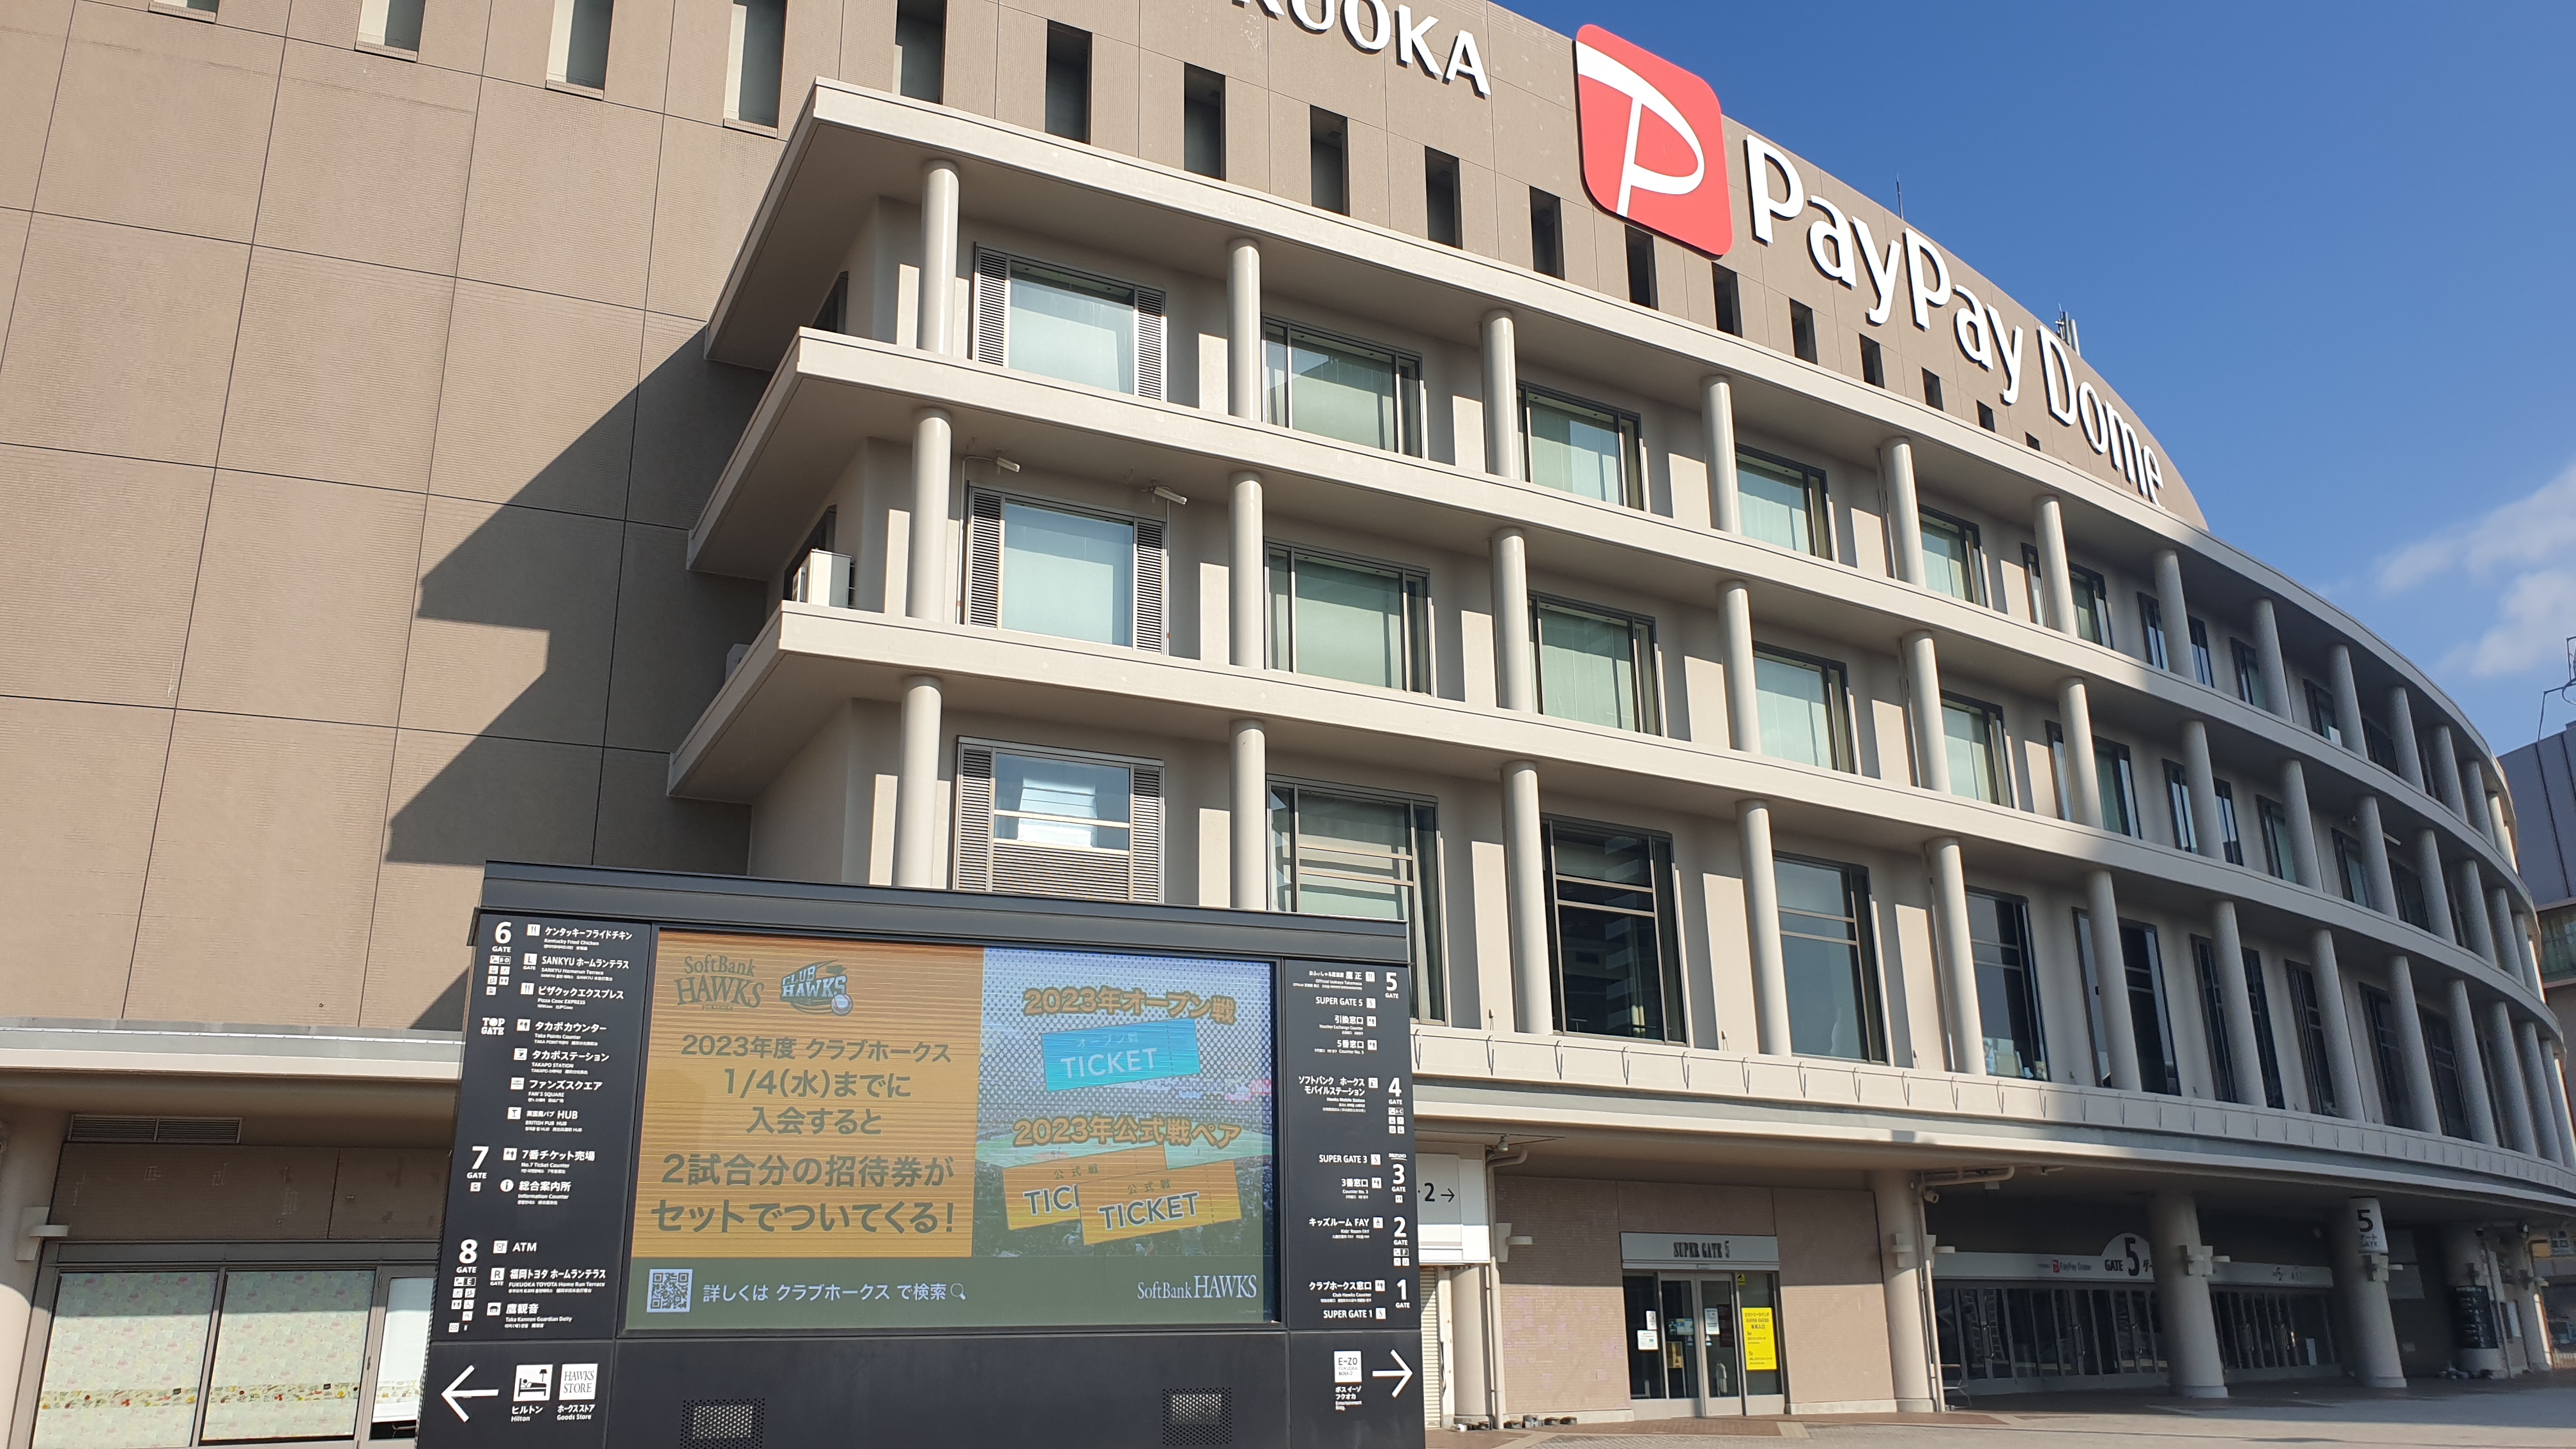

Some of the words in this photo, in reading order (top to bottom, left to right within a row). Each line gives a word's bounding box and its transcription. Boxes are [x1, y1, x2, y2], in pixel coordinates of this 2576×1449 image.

[1232, 0, 1491, 96] UOKA
[1746, 134, 2023, 406] PayPay
[2039, 325, 2166, 509] Dome
[495, 921, 512, 944] 6
[545, 927, 632, 940] ケンタッキーフライドチキン
[542, 956, 575, 966] SANKYU
[576, 958, 629, 969] ホームランテラス
[685, 954, 757, 977] SoftBank
[783, 965, 816, 986] CLUB
[1386, 972, 1398, 991] 5
[674, 974, 765, 1008] HAWKS
[782, 976, 847, 997] HAWKS
[1023, 985, 1237, 1025] 2023年オープン戦
[1316, 997, 1338, 1005] SUPER
[1340, 998, 1357, 1006] GATE
[481, 1027, 504, 1035] GATE
[482, 1017, 505, 1027] TOP
[681, 1034, 797, 1061] 2023年度
[806, 1038, 952, 1063] クラブホークス
[1061, 1048, 1157, 1078] TICKET
[530, 1080, 603, 1091] ファンズスクエア
[724, 1068, 911, 1098] 1/4(水)までに
[1298, 1075, 1334, 1085] ソフトバンク
[1340, 1077, 1365, 1086] ホークス
[1305, 1085, 1365, 1096] モバイルステーション
[1388, 1077, 1402, 1097] 4
[557, 1110, 578, 1119] HUB
[746, 1106, 882, 1135] 入会すると
[1013, 1116, 1241, 1148] 2023年公式戦ペア
[471, 1146, 489, 1169] 7
[522, 1149, 595, 1162] 7番チケット売場
[1319, 1154, 1342, 1163] SUPER
[661, 1153, 954, 1188] 2試合分の招待券が
[1393, 1163, 1405, 1184] 3
[518, 1181, 572, 1192] 総合案内所
[651, 1199, 954, 1234] セットでついてくる!
[1098, 1191, 1200, 1230] TICKET
[2357, 1209, 2373, 1232] 5
[1308, 1217, 1353, 1227] キッズルーム
[1354, 1218, 1370, 1227] FAY
[1393, 1216, 1407, 1238] 2
[459, 1239, 477, 1264] 8
[512, 1242, 537, 1252] ATM
[1673, 1242, 1699, 1257] SUPER
[1701, 1242, 1722, 1258] GATE
[1724, 1240, 1730, 1259] 5
[2104, 1259, 2124, 1271] GATE
[2124, 1237, 2140, 1276] 5
[550, 1269, 606, 1279] ホームランテラス
[703, 1284, 769, 1303] 詳しくは
[776, 1284, 891, 1301] クラブホークス
[897, 1283, 947, 1301] で検索
[1137, 1281, 1192, 1299] SoftBank
[1193, 1275, 1257, 1298] HAWKS
[1309, 1281, 1372, 1290] クラブホークス窓口
[1396, 1279, 1407, 1300] 1
[1323, 1310, 1347, 1319] SUPER
[1348, 1310, 1367, 1318] GATE
[1368, 1310, 1373, 1318] 1
[564, 1370, 594, 1381] HAWKS
[564, 1383, 592, 1393] STORE
[512, 1406, 543, 1414] ヒルトン
